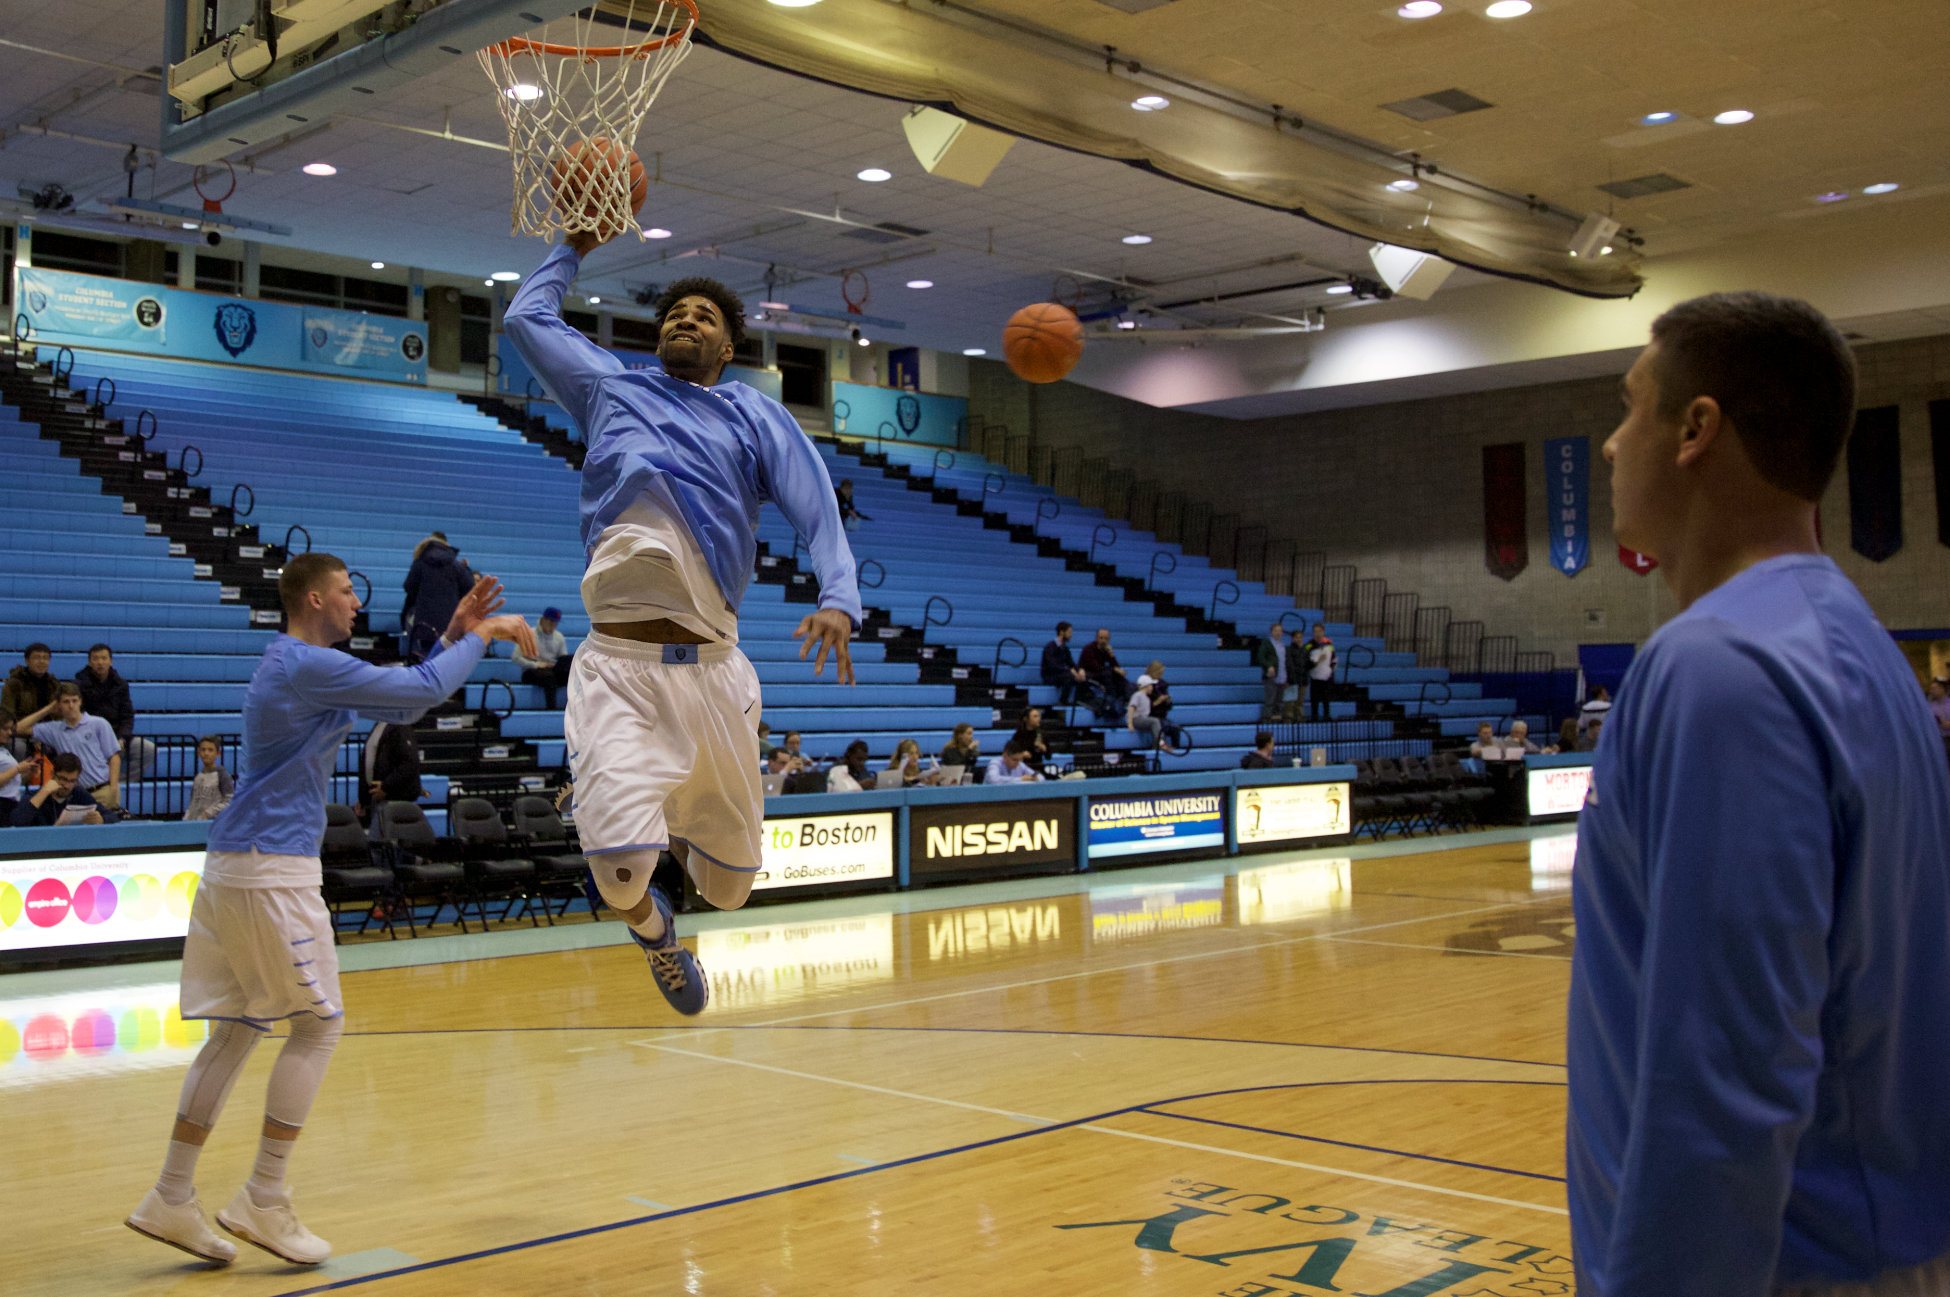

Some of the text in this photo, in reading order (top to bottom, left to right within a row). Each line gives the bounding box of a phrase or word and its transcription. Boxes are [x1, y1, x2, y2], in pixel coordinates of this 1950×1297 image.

[1561, 444, 1577, 569] COLUMBIA
[1090, 796, 1220, 820] COLUMBIA UNIVERSITY
[772, 826, 793, 849] to
[800, 822, 877, 847] Boston
[927, 819, 1058, 858] NISSAN
[784, 863, 866, 880] GoBuses.com
[1164, 1182, 1552, 1266] LEAGUE
[1052, 1203, 1513, 1297] IVY
